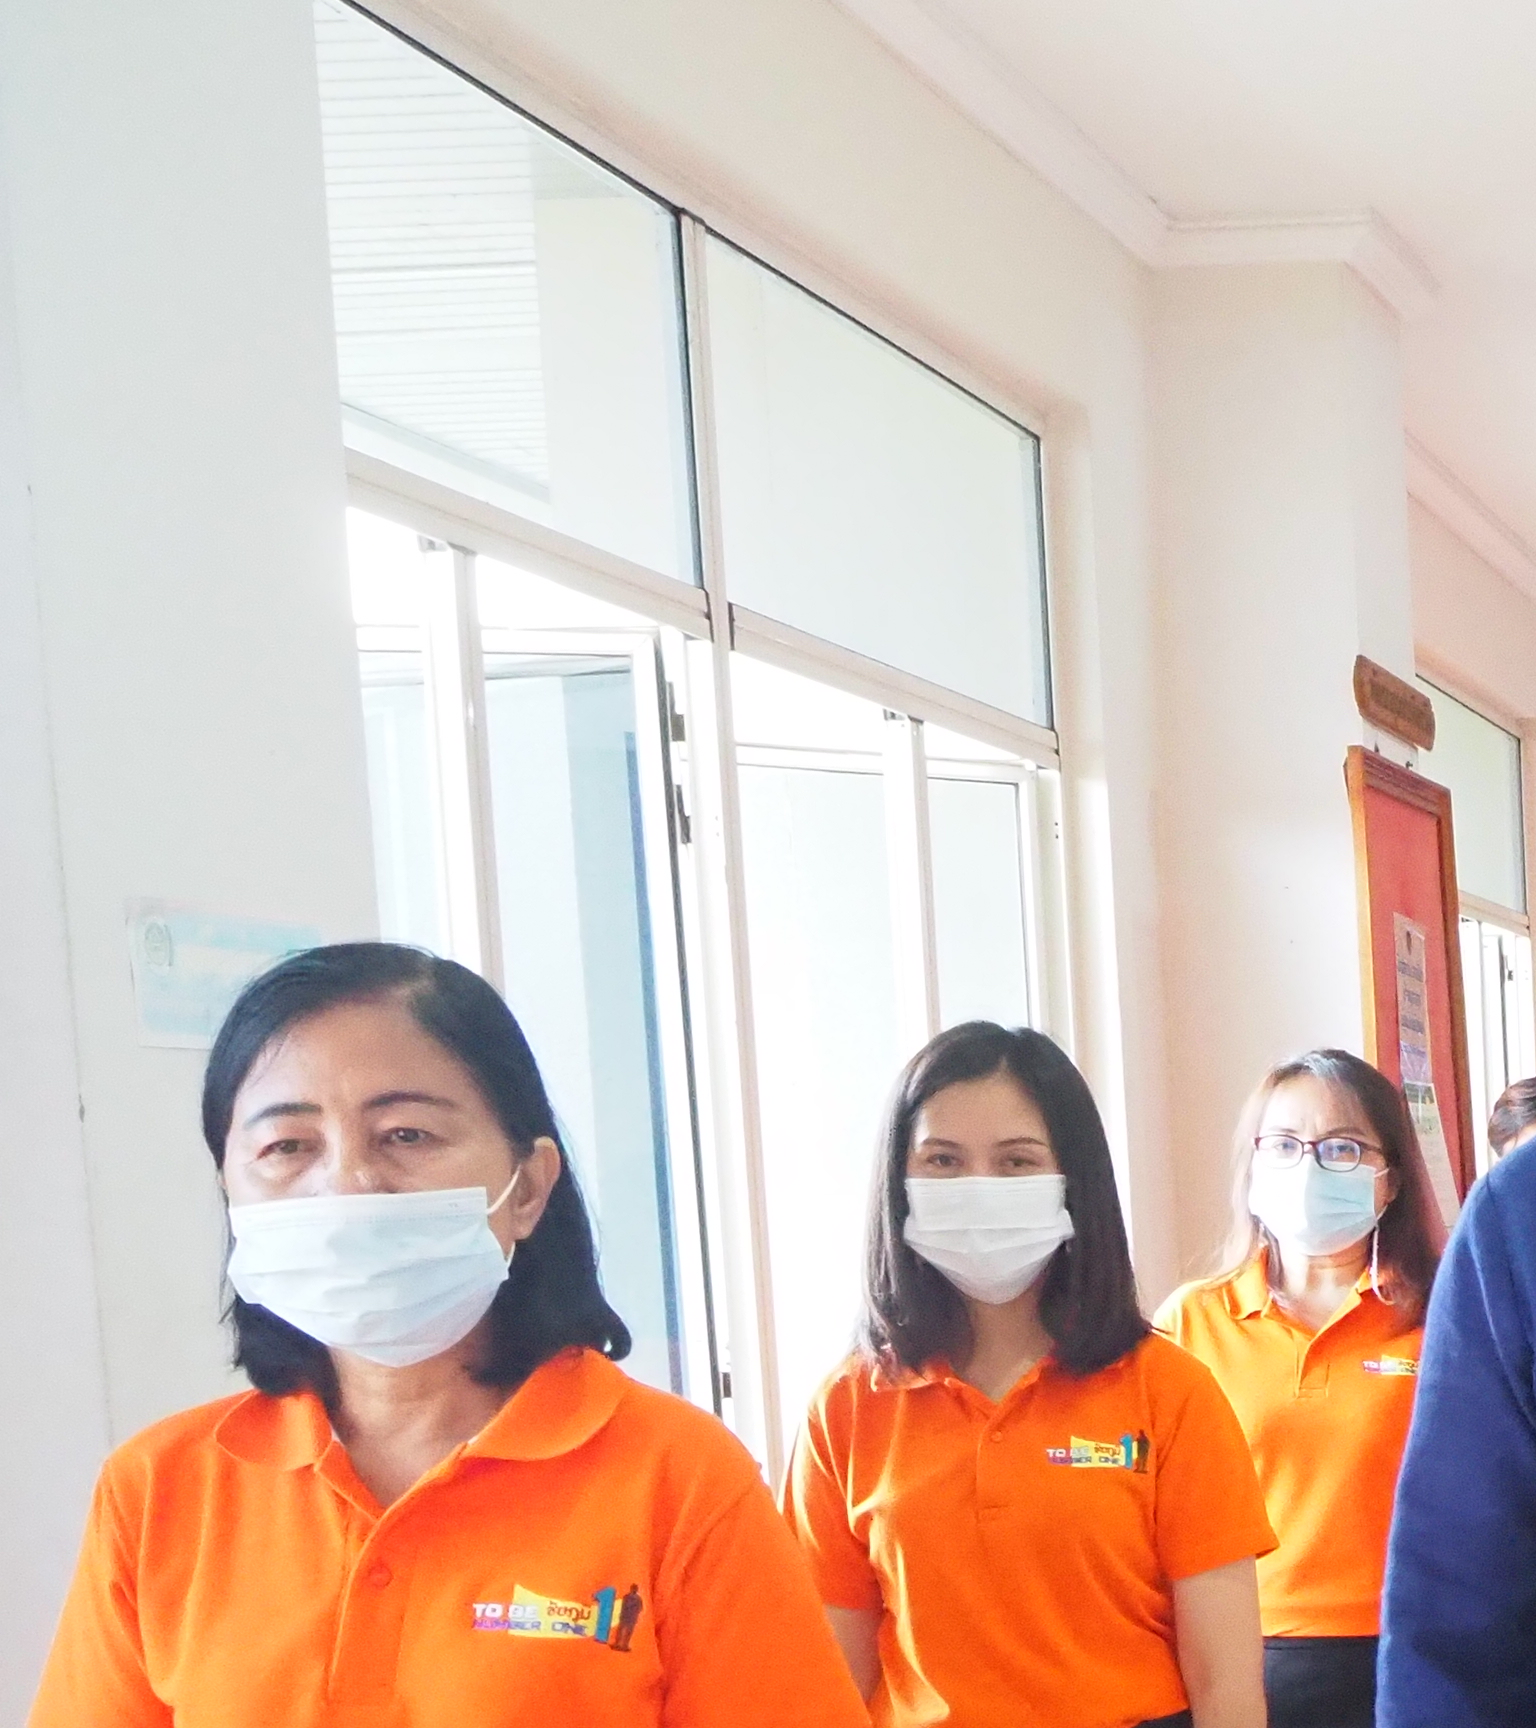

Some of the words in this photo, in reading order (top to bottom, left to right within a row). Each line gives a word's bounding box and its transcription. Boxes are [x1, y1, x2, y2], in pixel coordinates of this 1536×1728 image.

[1046, 1449, 1065, 1457] TO
[473, 1603, 503, 1618] TO
[508, 1603, 539, 1619] BE
[551, 1621, 588, 1637] ONE
